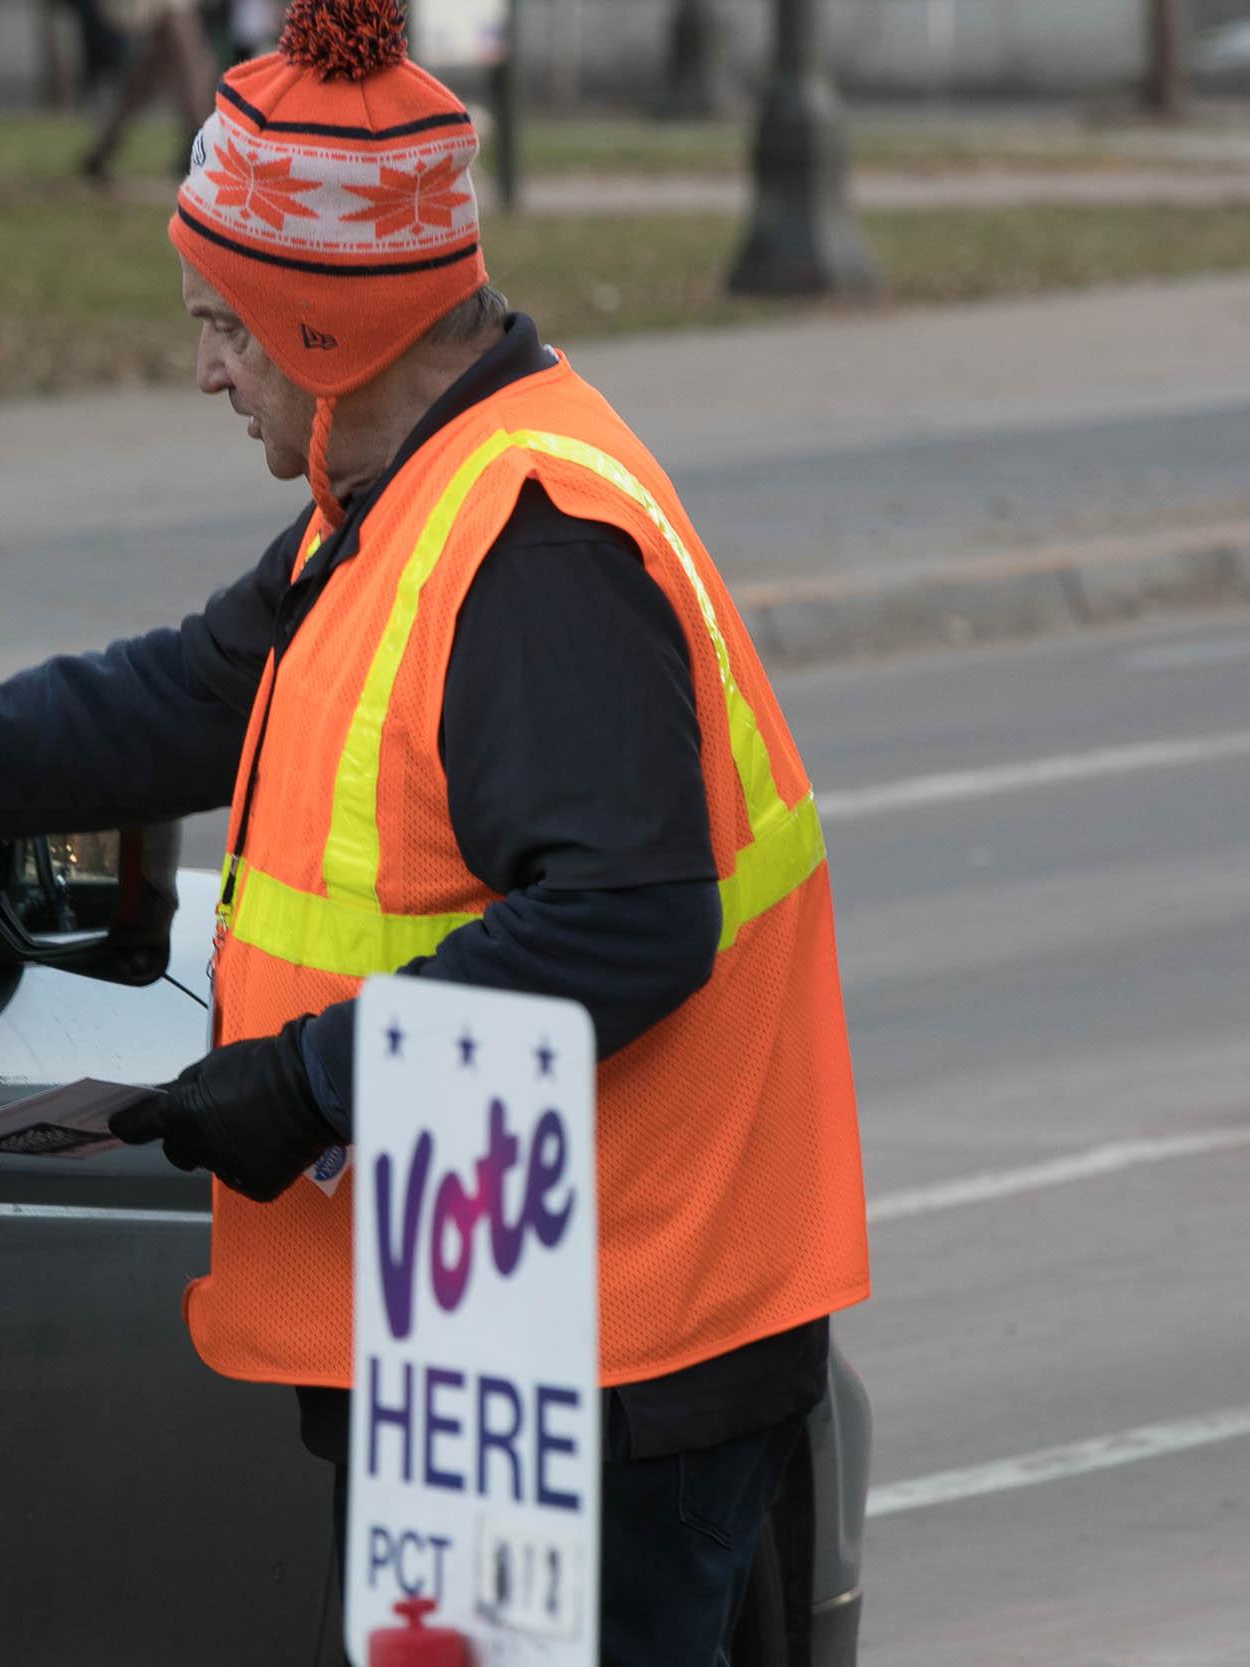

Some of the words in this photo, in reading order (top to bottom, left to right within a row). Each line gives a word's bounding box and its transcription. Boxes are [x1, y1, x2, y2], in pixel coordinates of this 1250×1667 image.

[374, 1096, 576, 1341] Vote
[367, 1353, 582, 1513] HERE
[368, 1524, 454, 1603] PCT
